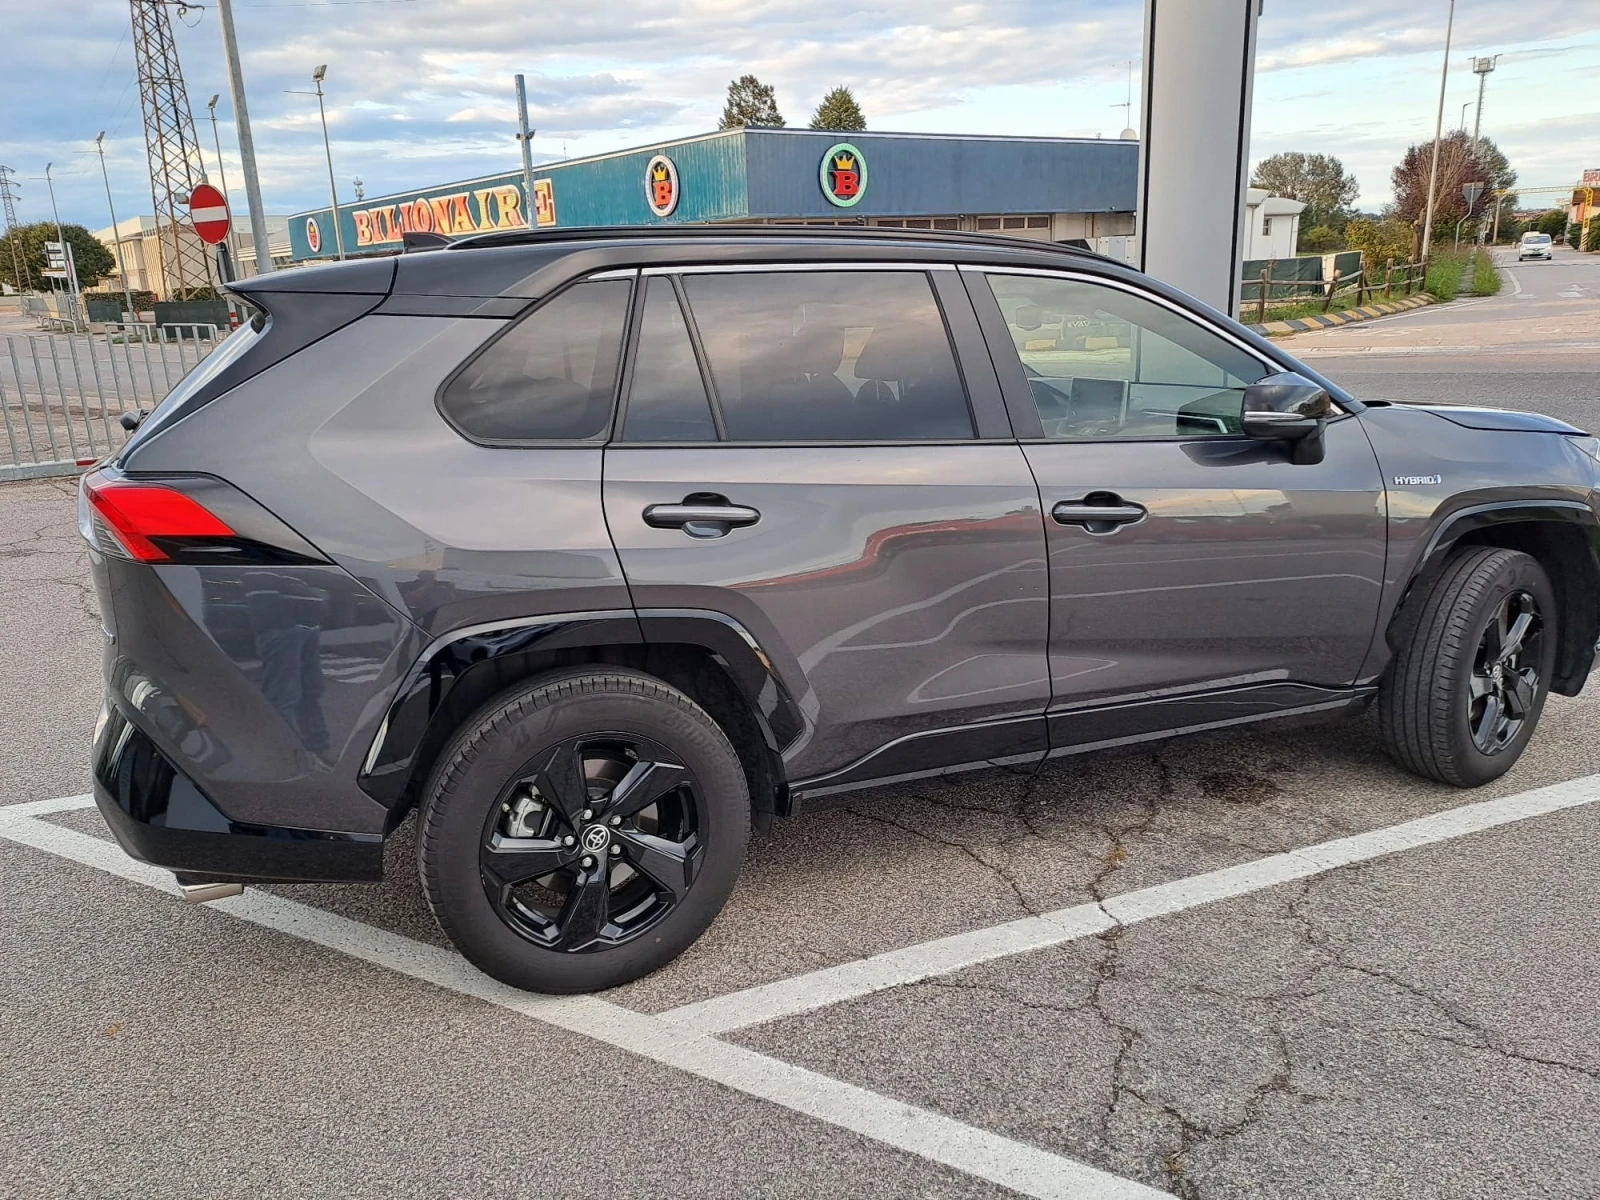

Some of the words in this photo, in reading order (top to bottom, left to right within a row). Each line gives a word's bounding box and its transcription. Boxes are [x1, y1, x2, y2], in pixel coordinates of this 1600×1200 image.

[831, 170, 860, 195] B
[1583, 171, 1600, 182] BR
[653, 181, 673, 206] B
[1394, 476, 1434, 485] HYBRID
